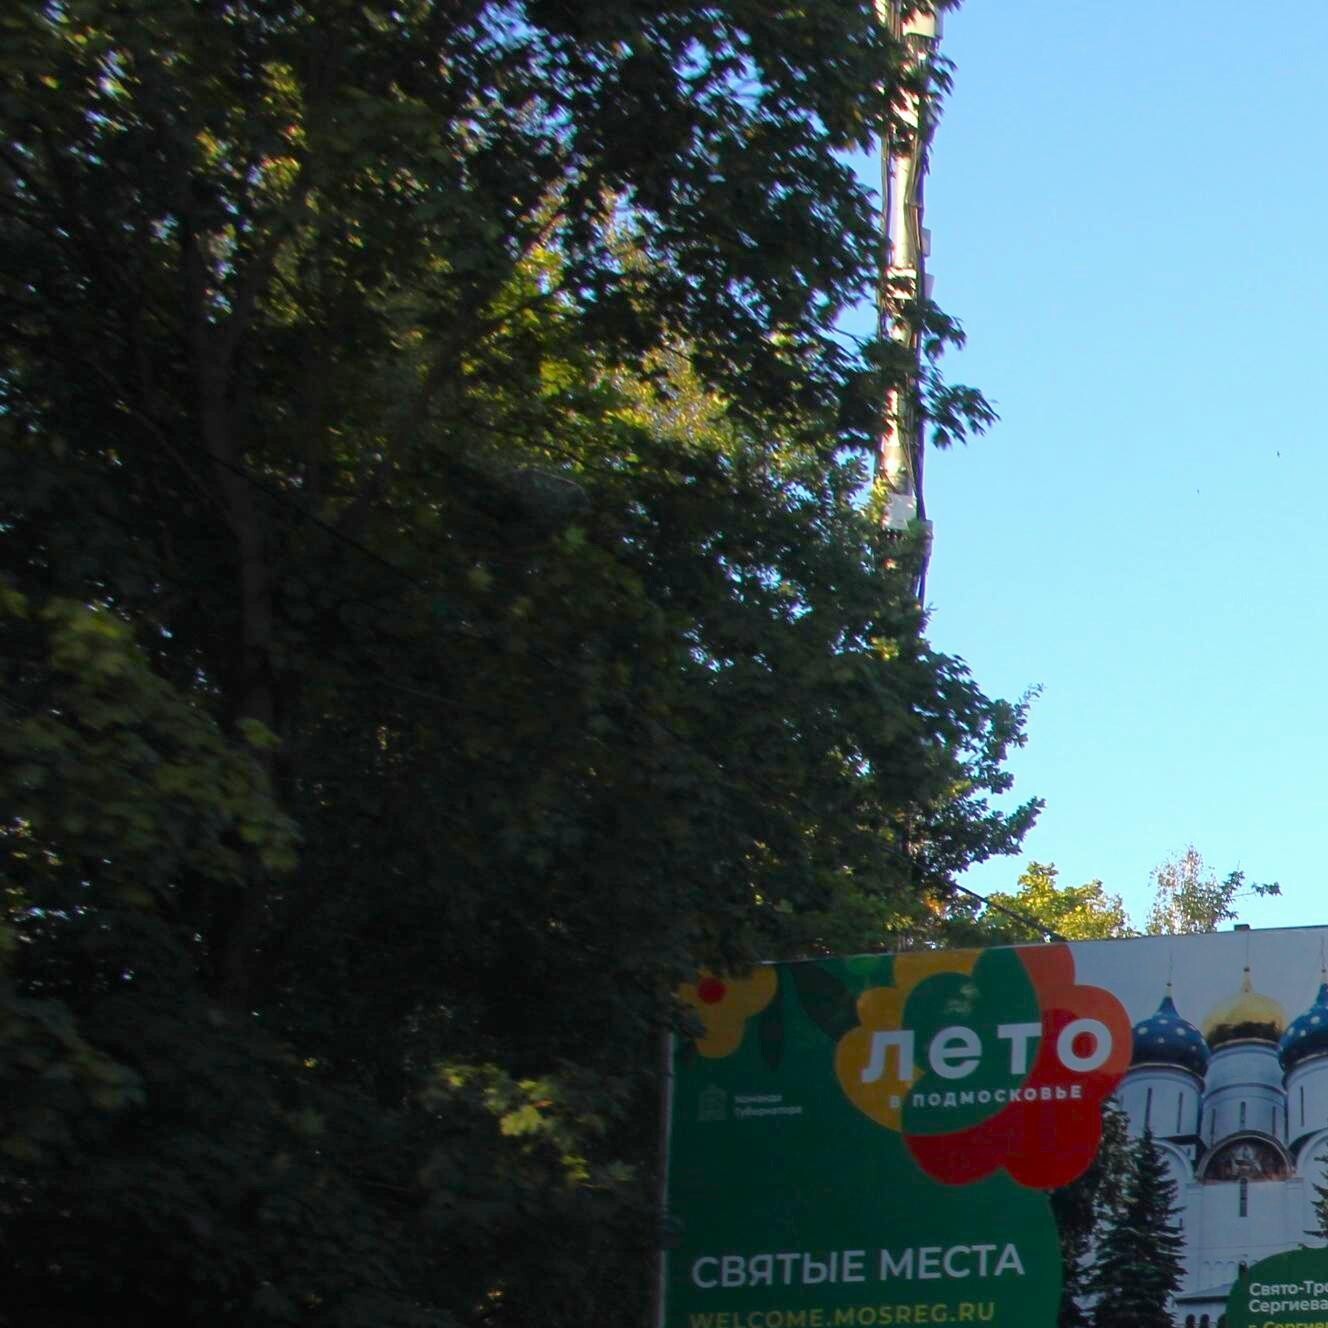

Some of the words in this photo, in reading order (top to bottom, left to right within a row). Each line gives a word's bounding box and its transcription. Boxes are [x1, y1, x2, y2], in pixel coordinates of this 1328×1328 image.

[861, 1018, 1113, 1083] лето
[912, 1085, 1082, 1109] ПОДМОСКОВЬЕ
[691, 1250, 866, 1289] СВЯТЫЕ
[879, 1243, 1025, 1281] МЕСТА
